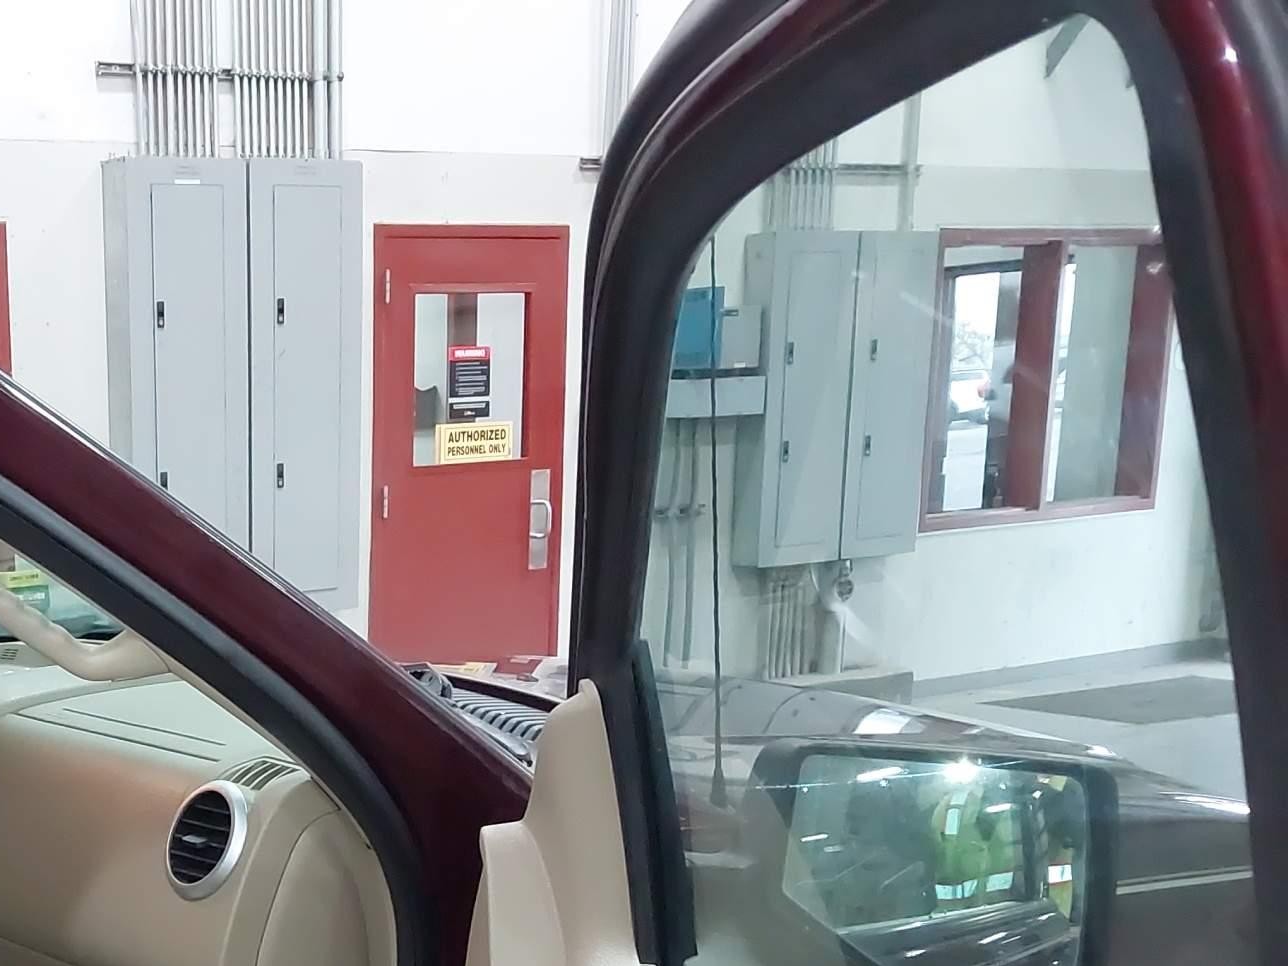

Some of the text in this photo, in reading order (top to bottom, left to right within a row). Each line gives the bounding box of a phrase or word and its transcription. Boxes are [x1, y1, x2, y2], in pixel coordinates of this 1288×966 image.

[448, 429, 507, 443] AUTHORIZED
[447, 443, 506, 457] PERSONNEL ONLY
